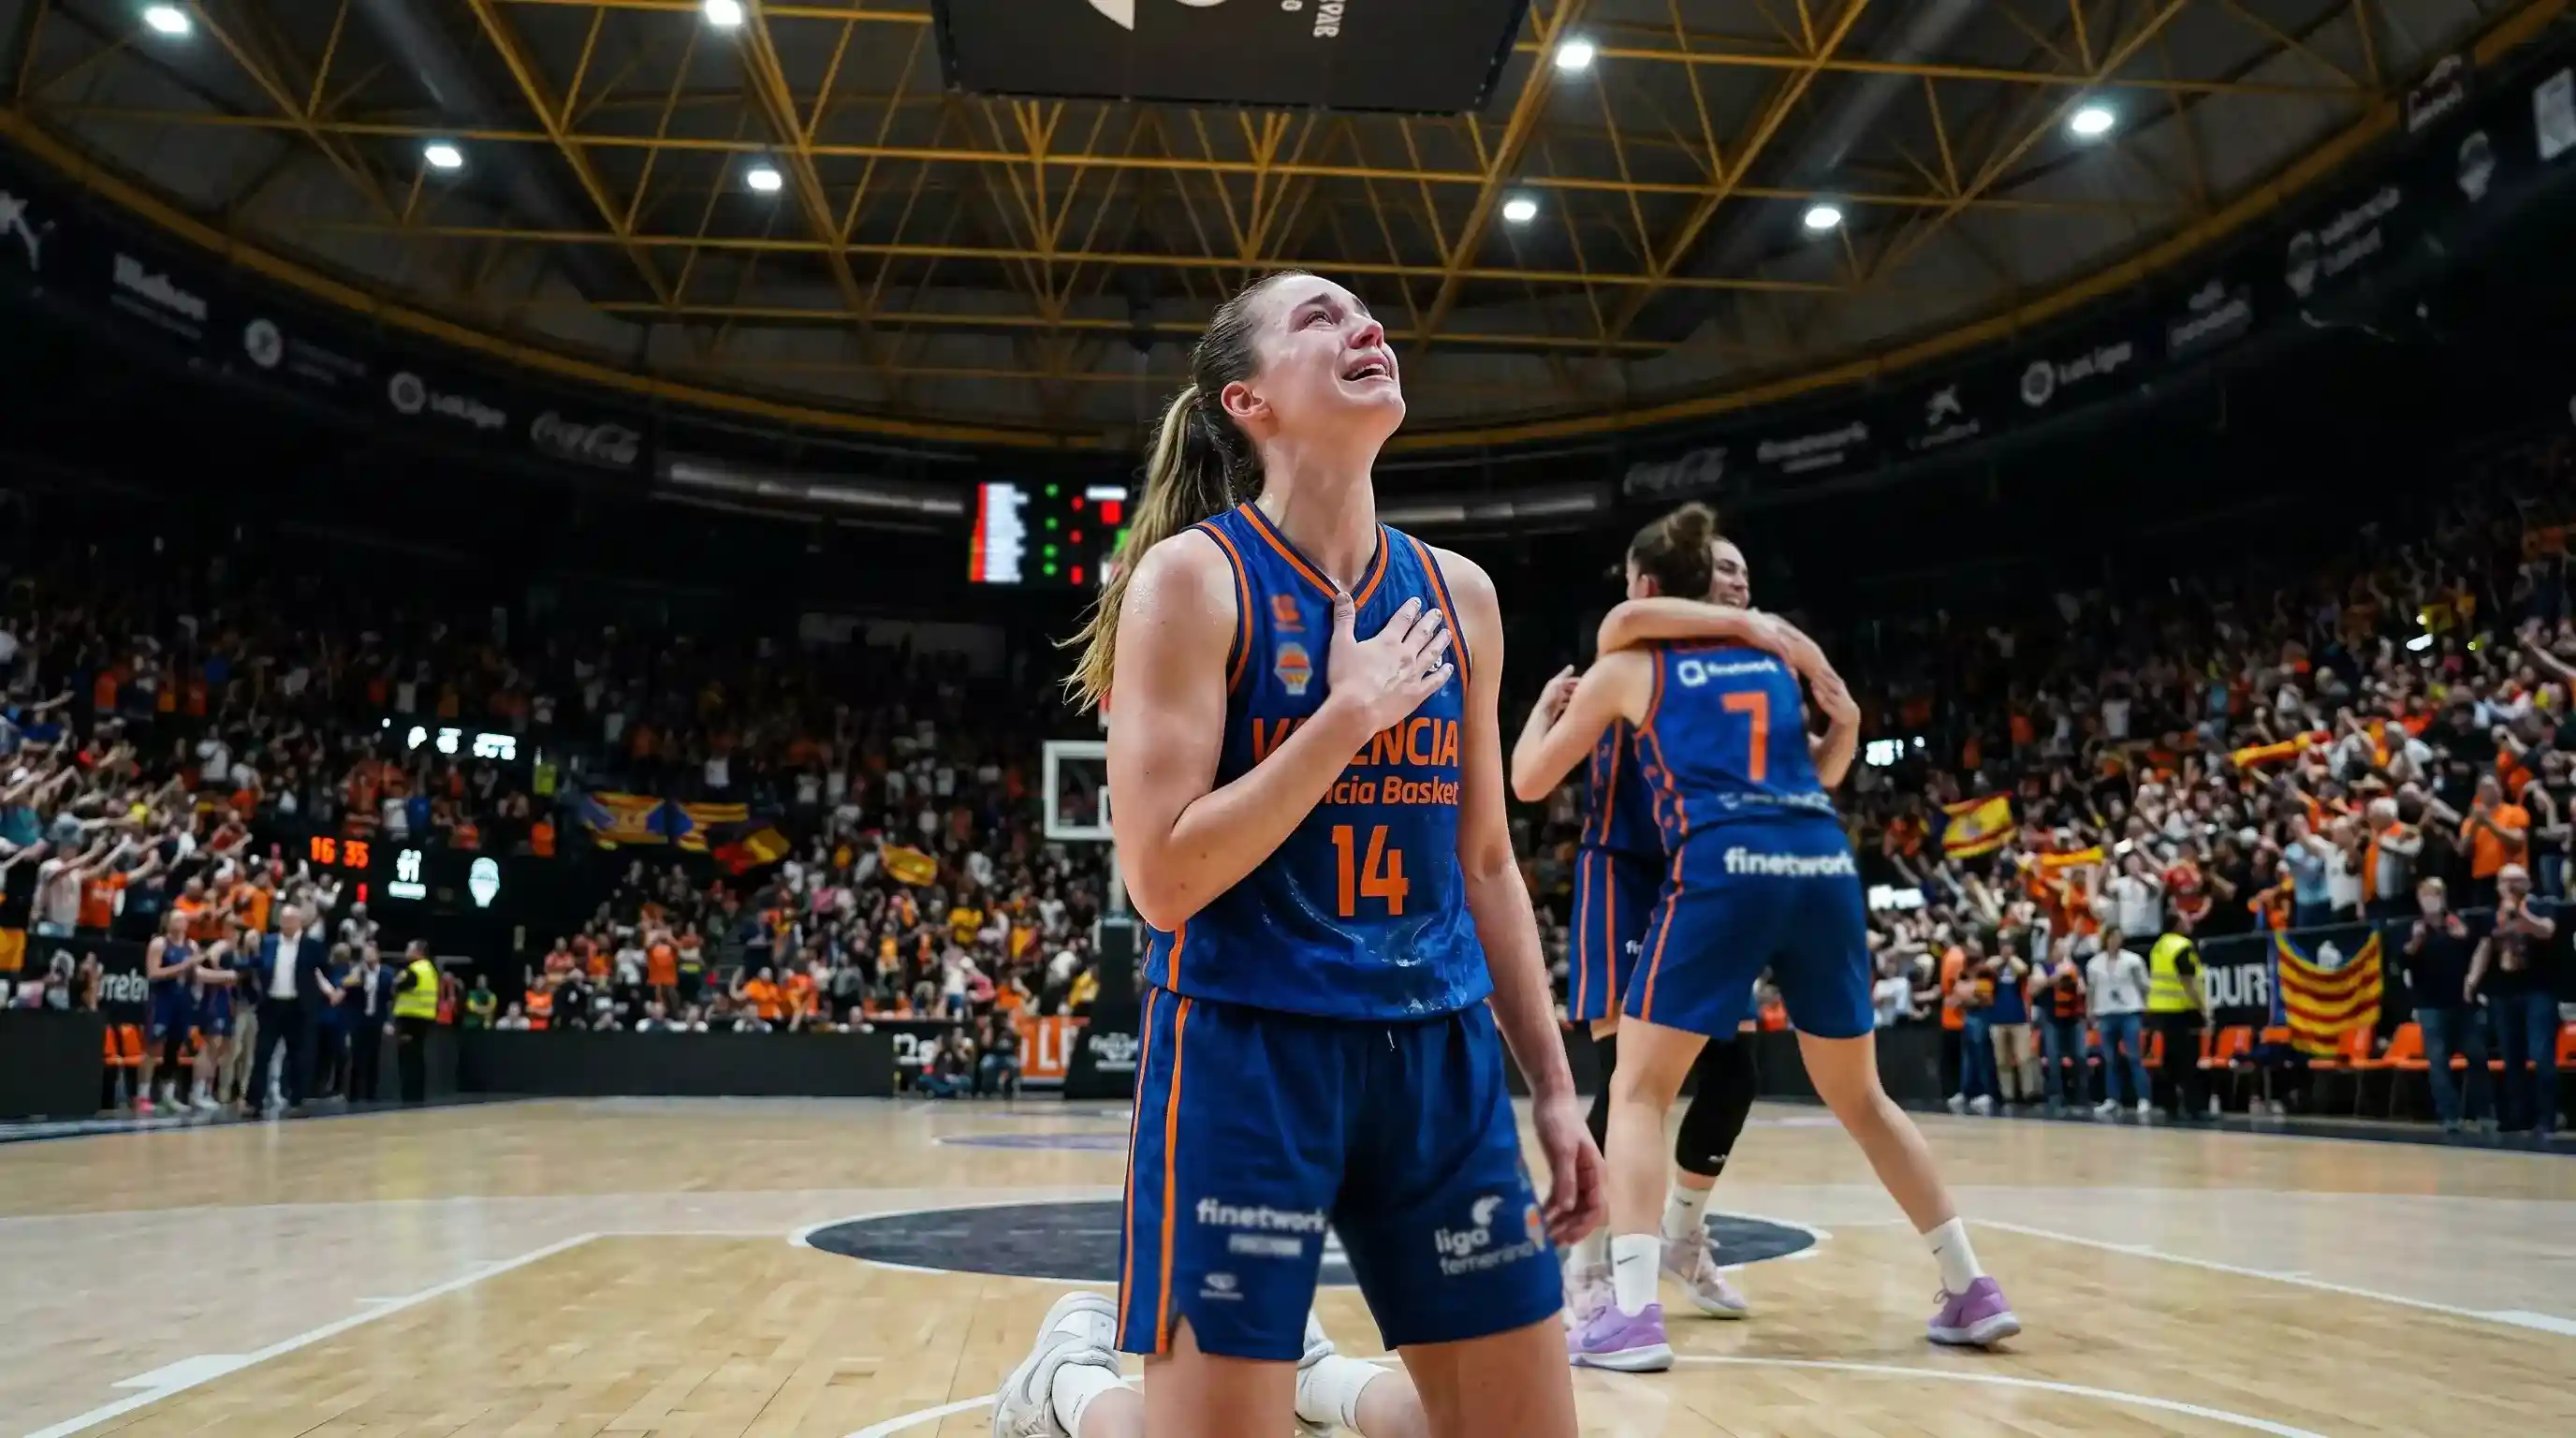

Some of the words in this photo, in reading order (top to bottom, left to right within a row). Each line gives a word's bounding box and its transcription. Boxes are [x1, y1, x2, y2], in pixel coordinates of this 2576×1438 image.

[1252, 718, 1459, 768] VNCIA
[1720, 691, 1770, 784] 7
[1382, 776, 1459, 805] Basket
[1331, 825, 1409, 917] 14
[1723, 845, 1857, 877] finetwork
